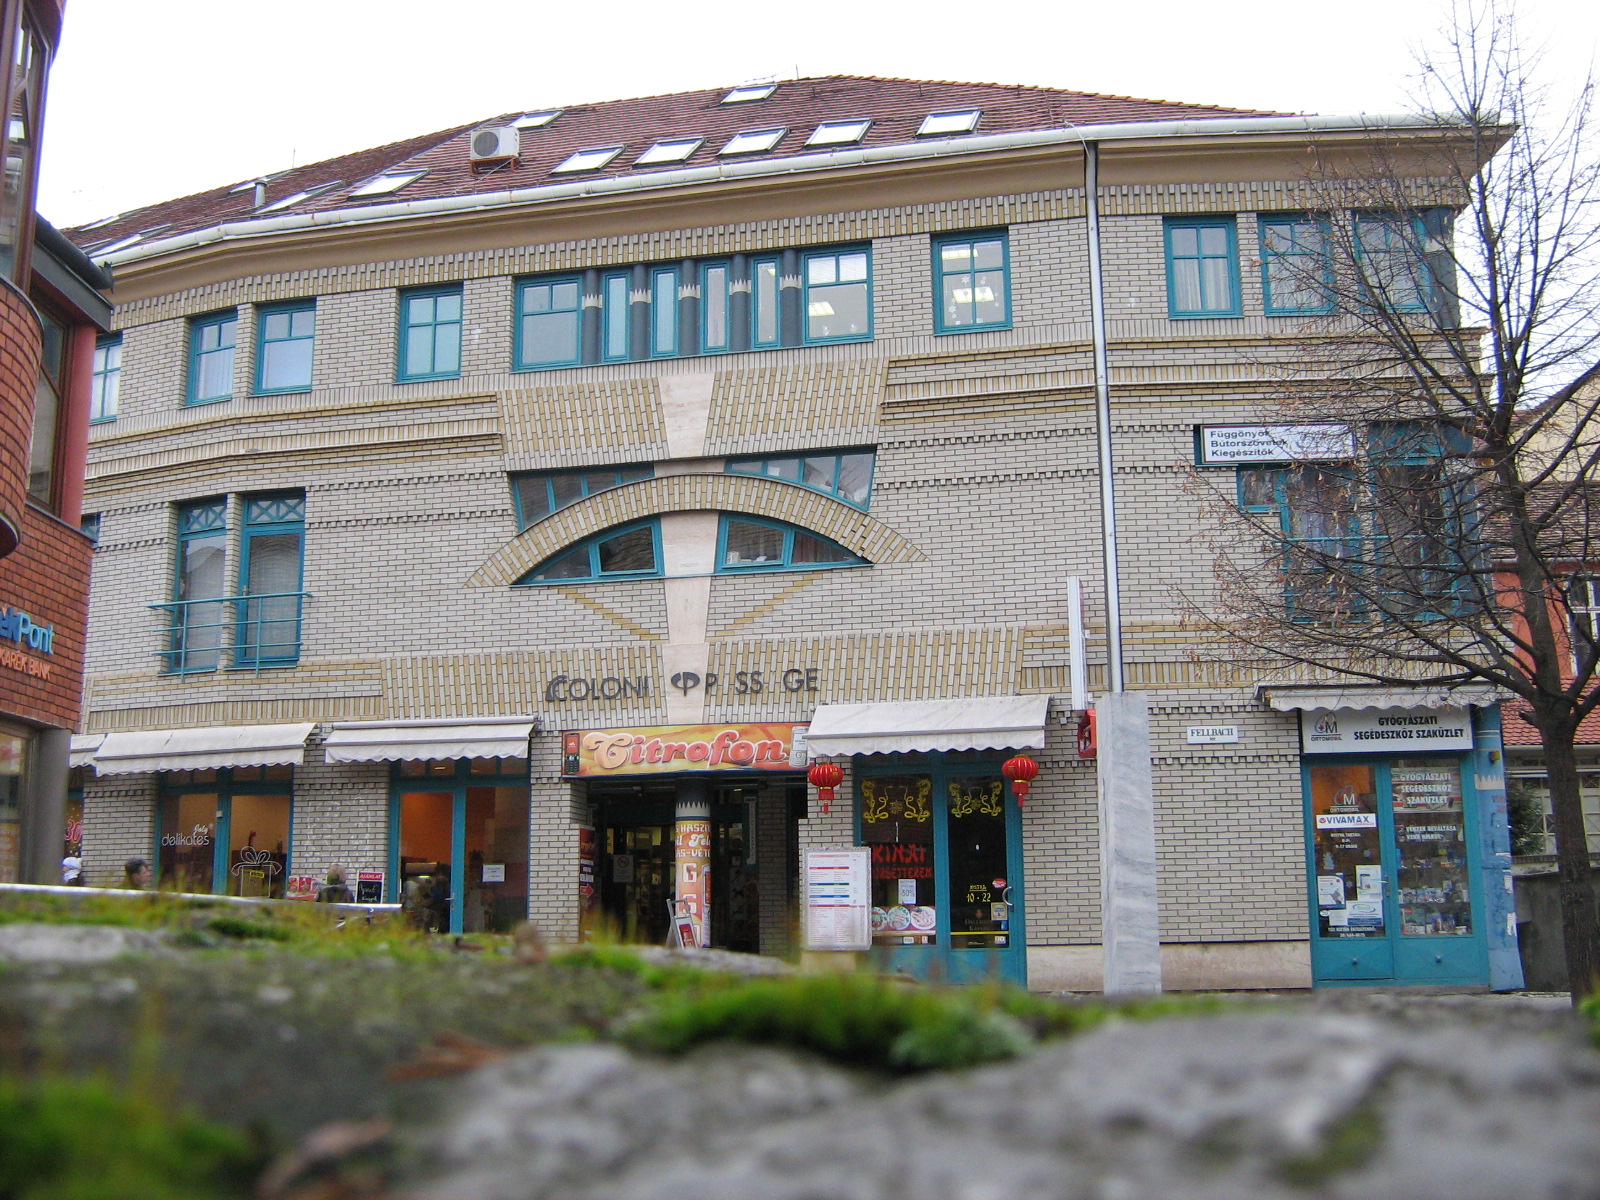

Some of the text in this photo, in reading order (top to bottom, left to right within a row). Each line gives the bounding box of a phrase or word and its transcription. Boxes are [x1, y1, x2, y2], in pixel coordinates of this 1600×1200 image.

[1210, 429, 1270, 439] Függönyök
[1211, 449, 1274, 459] Kiegészítők
[28, 658, 51, 680] BANK
[1378, 715, 1438, 726] GYÓGYÁSZATI
[1190, 728, 1234, 736] FELLBACH
[1354, 727, 1464, 740] SEGÉDESZKÖZ SZAKÜZLET
[582, 730, 788, 770] Citrofon
[1400, 773, 1451, 781] GYÓGYÁSZATI
[1401, 783, 1453, 792] SEGÉDESZKÖZ
[1406, 794, 1448, 804] SZAKÜZLET
[1326, 815, 1370, 824] VIVAMAX
[161, 833, 210, 846] delikates
[966, 892, 975, 902] 10
[982, 892, 991, 902] 22
